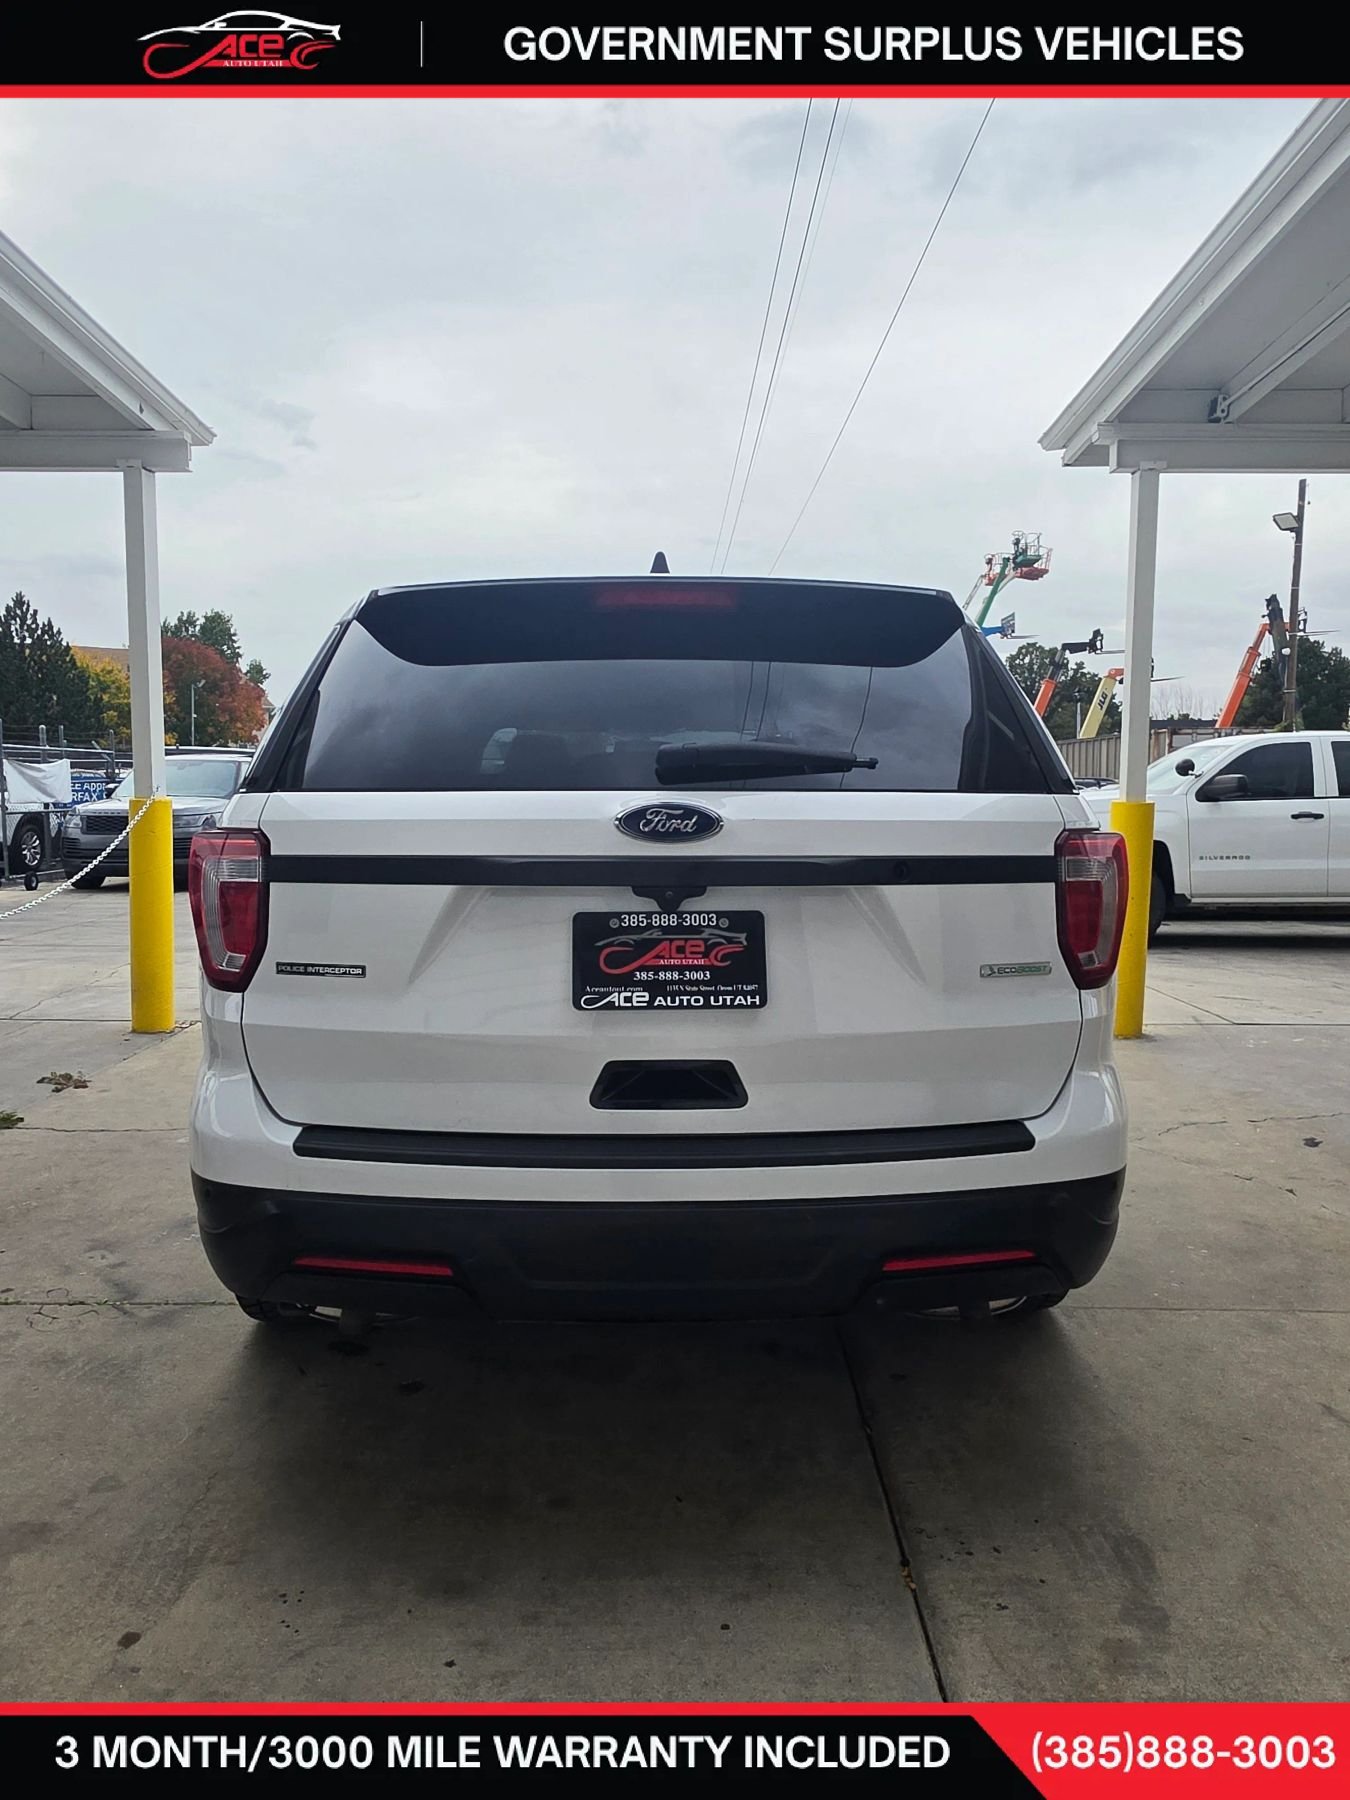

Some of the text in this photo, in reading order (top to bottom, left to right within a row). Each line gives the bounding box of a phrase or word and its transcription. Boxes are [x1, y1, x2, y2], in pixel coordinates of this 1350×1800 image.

[1097, 691, 1108, 710] JLG
[640, 808, 698, 832] Ford
[620, 913, 717, 927] 385-888-3003
[278, 965, 362, 974] POLICE INTERCEPTOR
[633, 970, 711, 981] 385-888-3003
[653, 995, 704, 1007] AUTO
[710, 995, 760, 1006] UTAH
